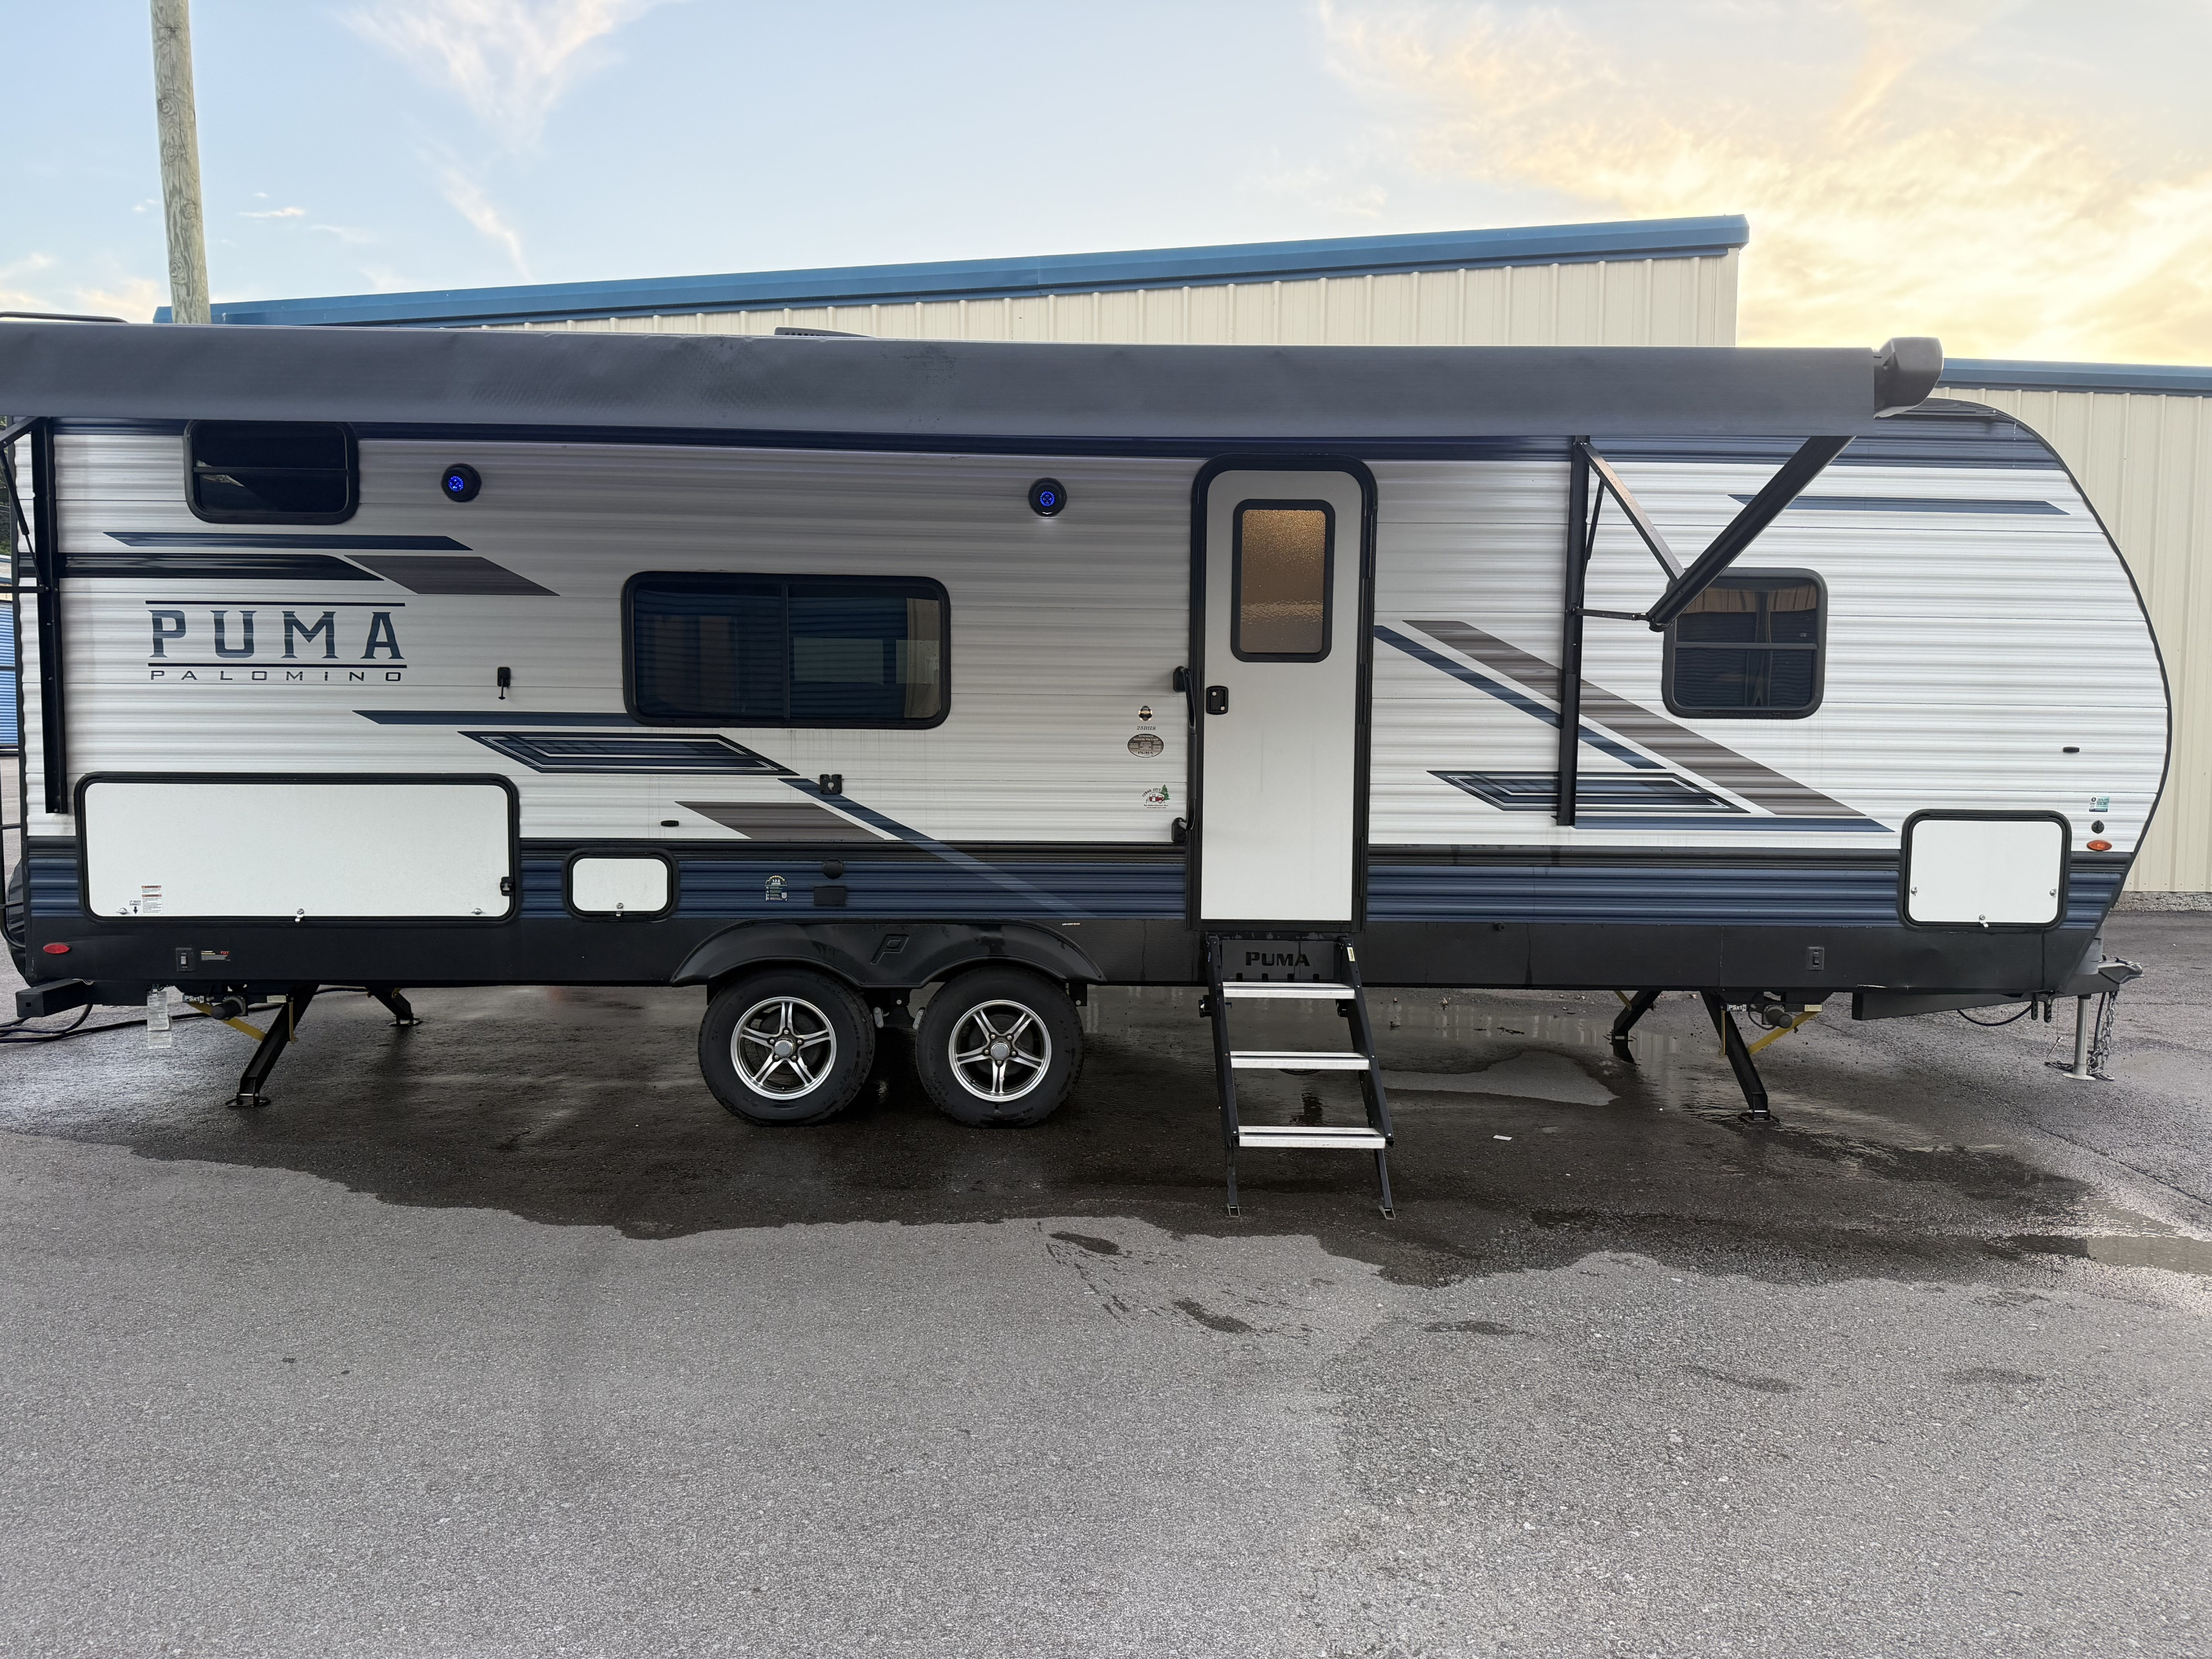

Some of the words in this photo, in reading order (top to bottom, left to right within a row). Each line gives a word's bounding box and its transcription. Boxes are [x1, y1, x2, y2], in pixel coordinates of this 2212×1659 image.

[147, 609, 405, 659] PUMA
[150, 670, 401, 682] PALOMINO
[1245, 952, 1310, 967] PUMA
